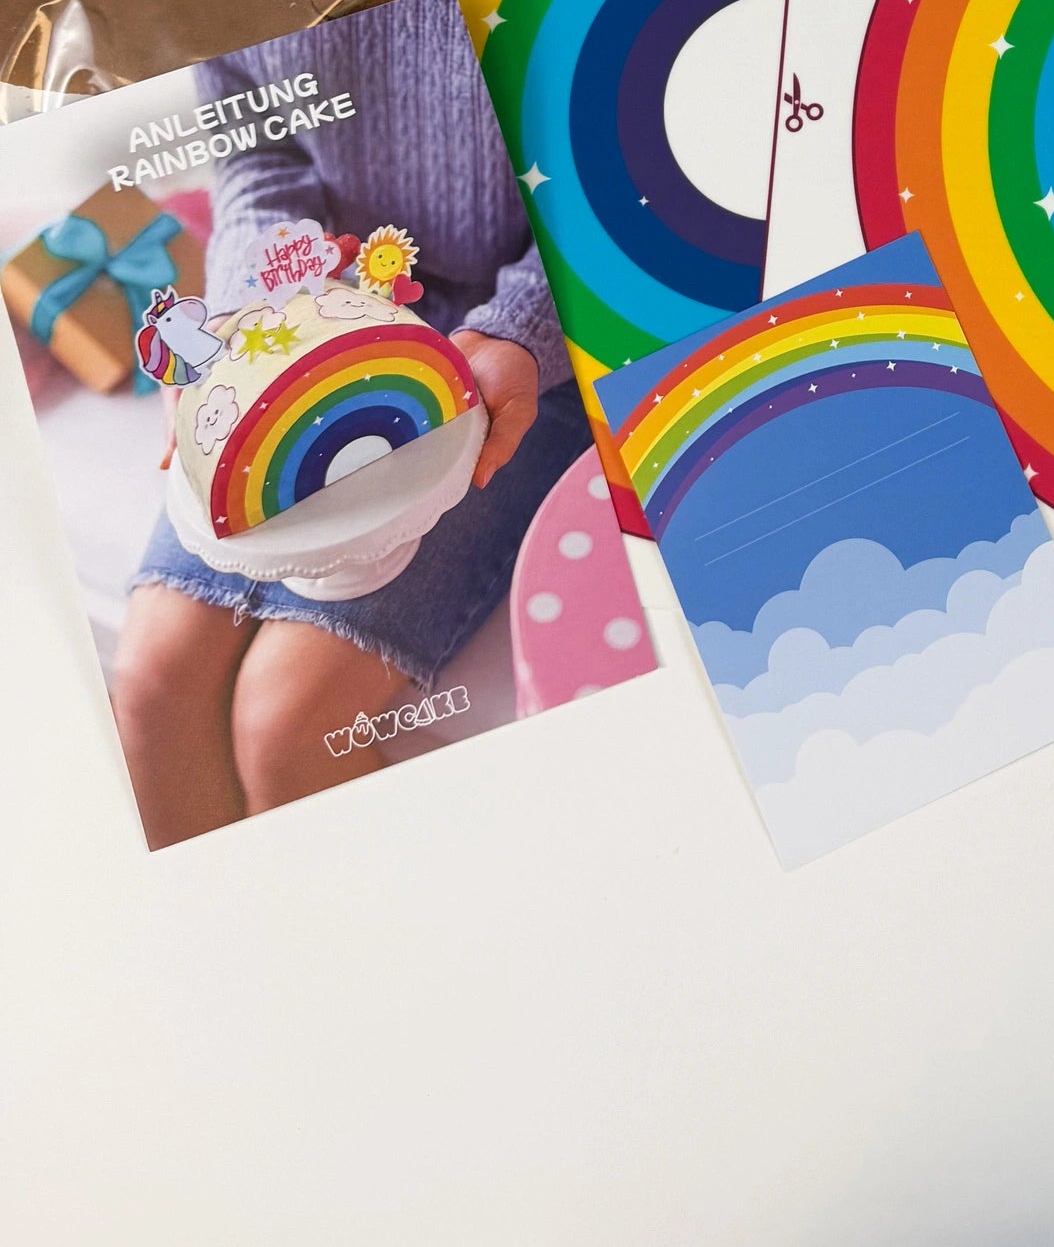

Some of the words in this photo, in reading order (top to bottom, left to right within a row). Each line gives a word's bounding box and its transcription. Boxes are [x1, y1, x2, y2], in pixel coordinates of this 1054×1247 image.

[107, 122, 258, 193] RAINBOW
[263, 92, 357, 141] CAKE
[129, 71, 319, 153] ANLEITUNG
[265, 234, 319, 268] Happy
[323, 685, 471, 758] WOWCAKE
